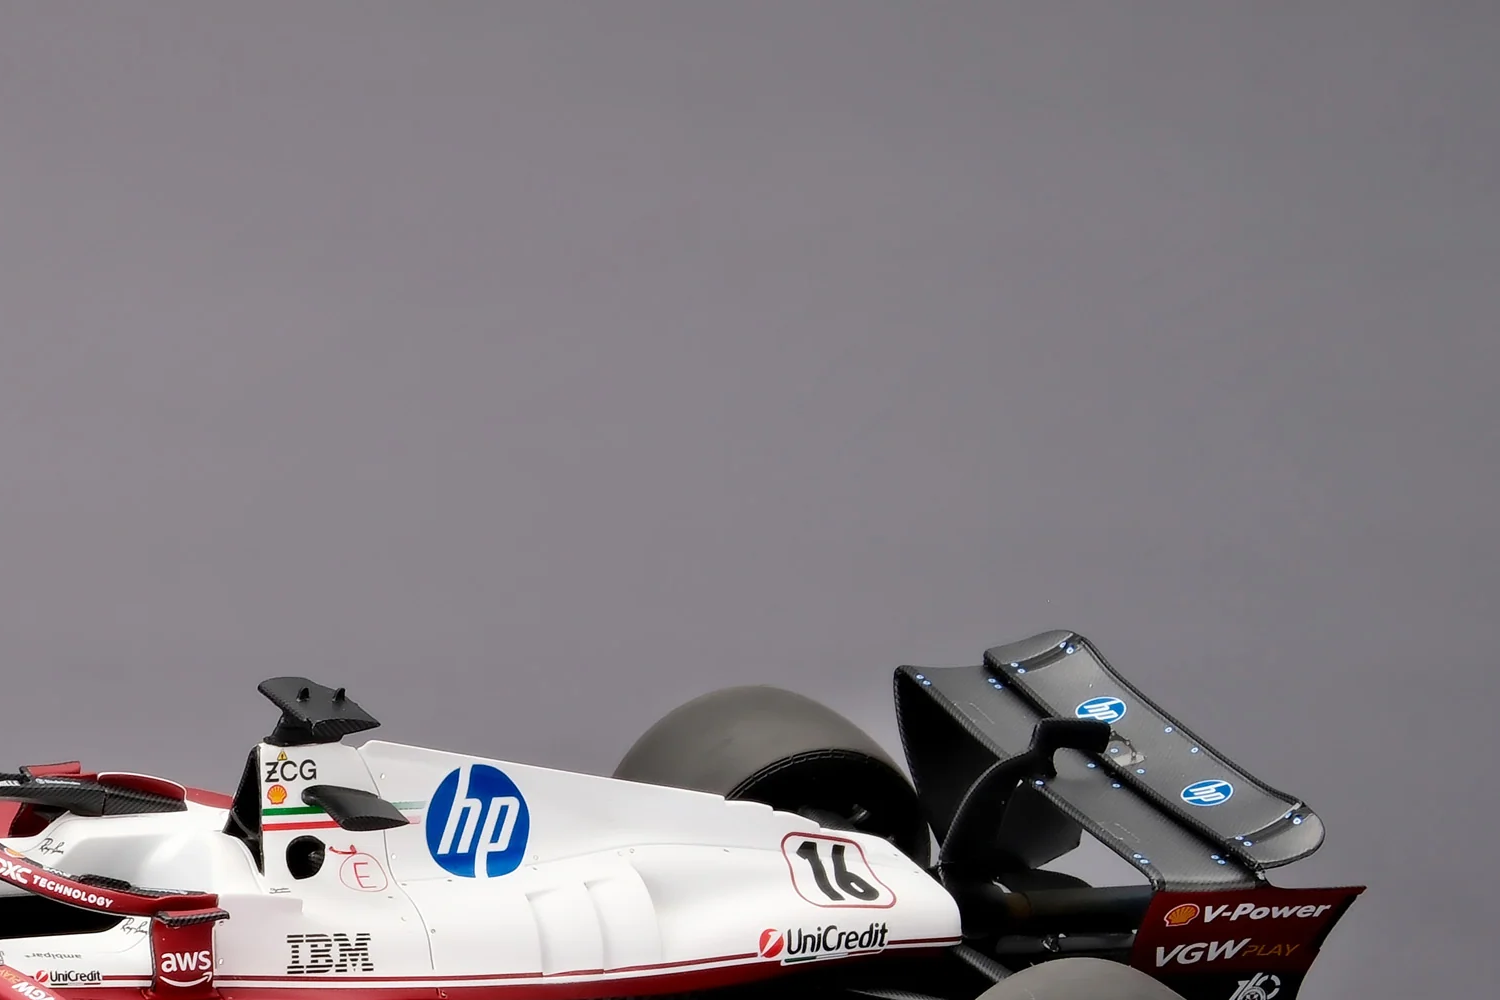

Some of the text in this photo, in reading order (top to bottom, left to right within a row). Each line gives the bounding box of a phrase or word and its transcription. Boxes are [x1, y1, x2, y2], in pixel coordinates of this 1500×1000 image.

[1190, 781, 1225, 805] hp
[437, 764, 520, 878] hp
[353, 862, 377, 889] E
[796, 841, 880, 901] 16
[32, 874, 113, 908] TECHNOLOGY
[1204, 903, 1332, 923] V-Power
[287, 932, 374, 974] IBM
[787, 922, 889, 955] UniCredit
[1156, 938, 1300, 967] VGW PLAY
[161, 950, 212, 973] aws
[49, 970, 102, 983] UniCredit
